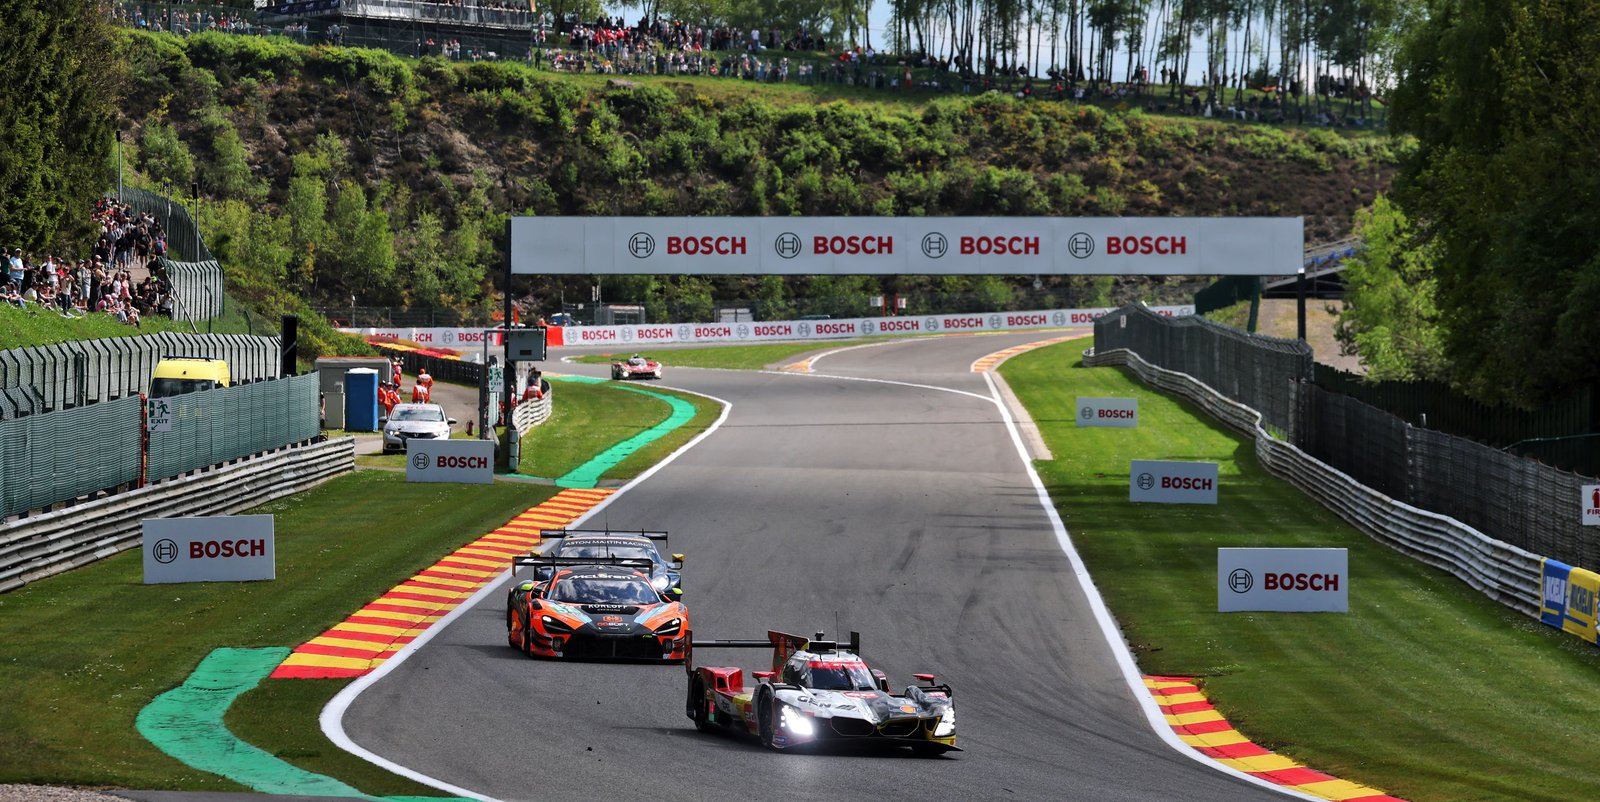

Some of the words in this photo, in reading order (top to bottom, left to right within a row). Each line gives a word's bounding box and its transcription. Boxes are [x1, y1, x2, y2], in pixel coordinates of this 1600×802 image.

[667, 236, 747, 255] BOSCH
[813, 236, 893, 255] BOSCH
[960, 236, 1040, 255] BOSCH
[1106, 236, 1187, 255] BOSCH
[582, 330, 616, 340] BOSCH
[638, 329, 673, 338] BOSCH
[695, 327, 731, 337] BOSCH
[755, 325, 792, 336] BOSCH
[816, 323, 855, 334] BOSCH
[880, 320, 919, 332] BOSCH
[943, 317, 983, 329] BOSCH
[1007, 315, 1047, 326] BOSCH
[458, 332, 493, 342] BOSCH
[1098, 409, 1134, 419] BOSCH
[437, 455, 488, 469] BOSCH
[1161, 476, 1213, 491] BOSCH
[190, 539, 265, 559] BOSCH
[1264, 572, 1339, 591] BOSCH
